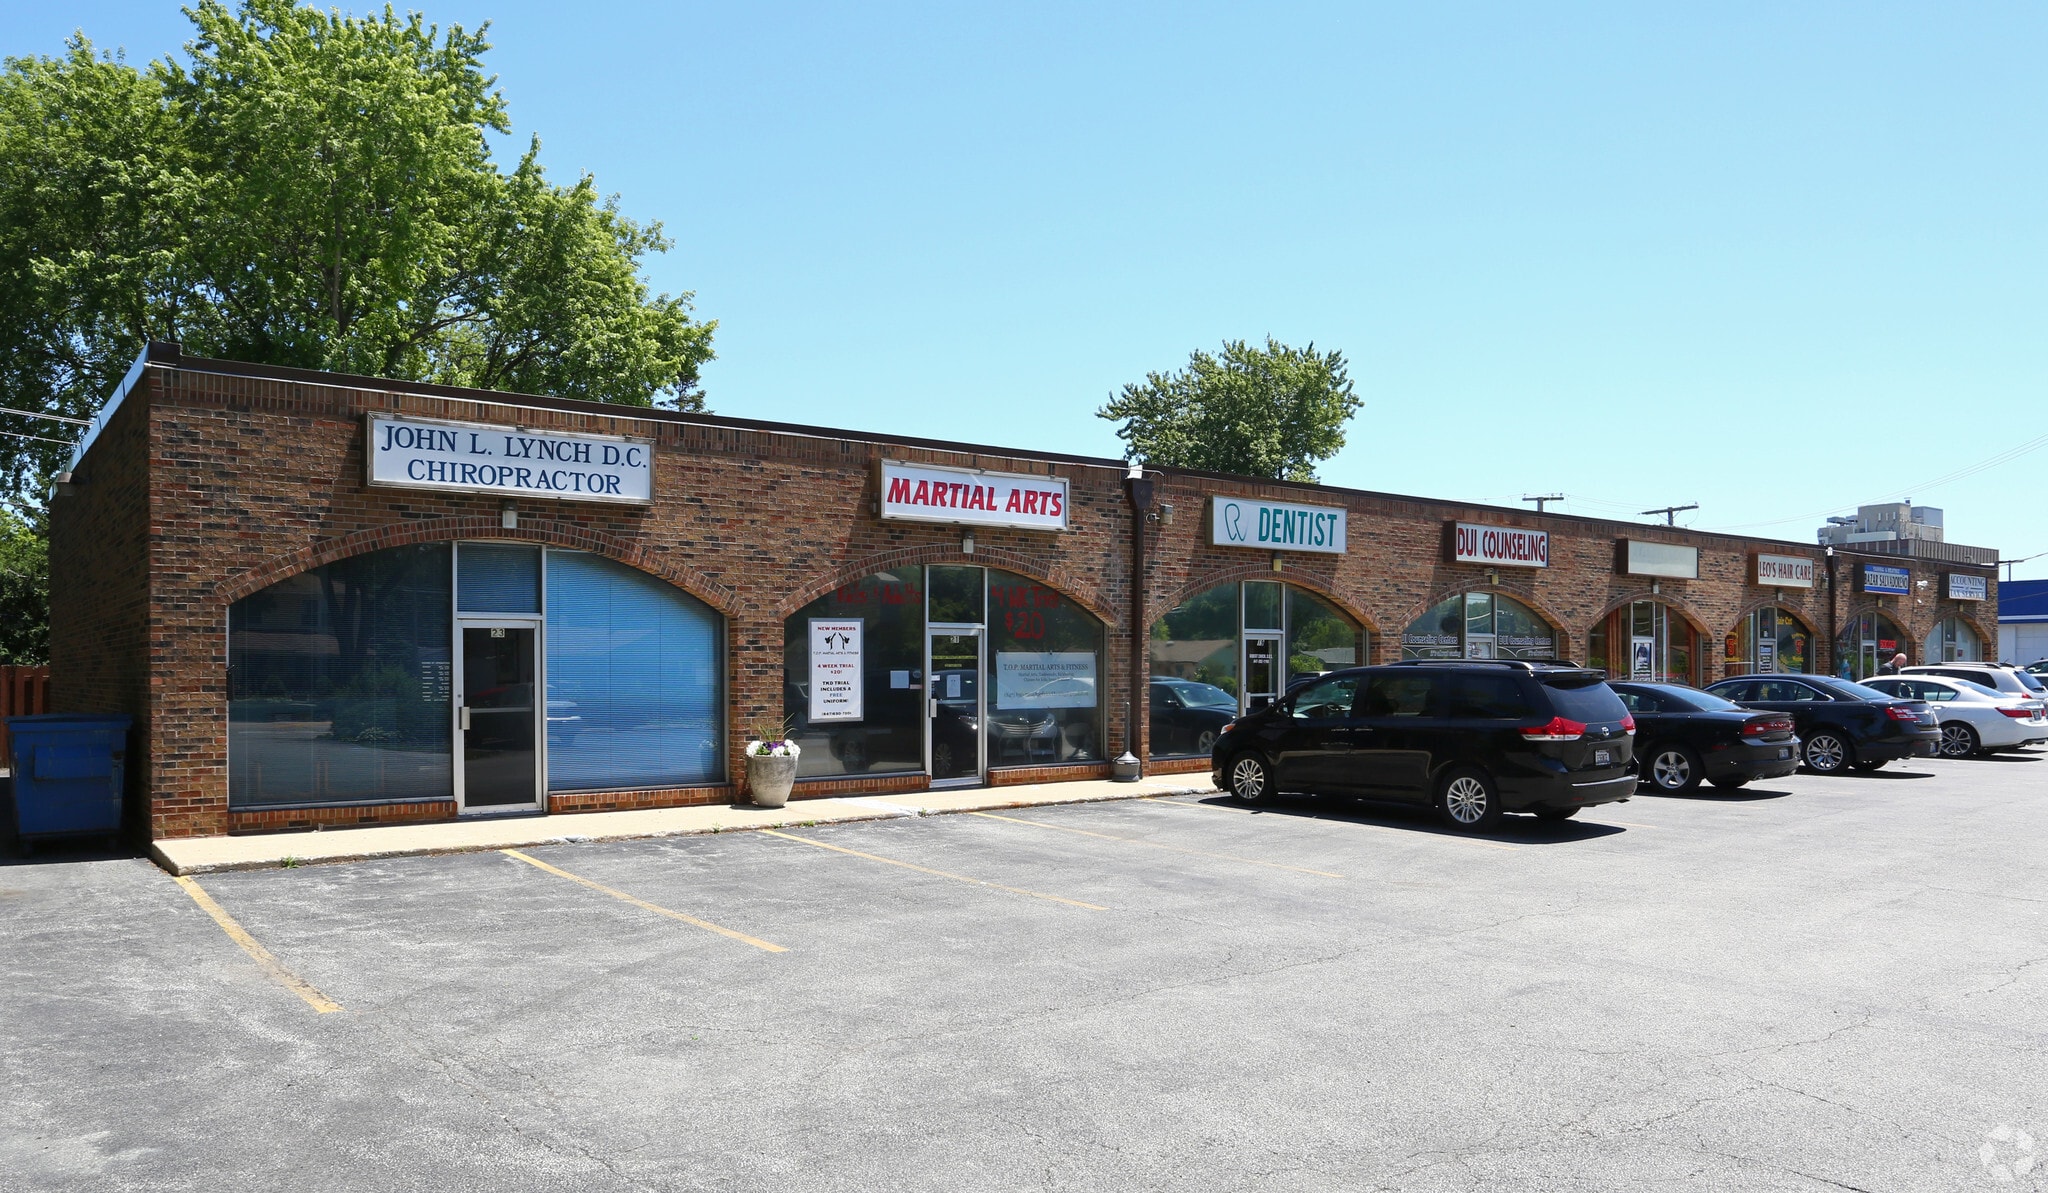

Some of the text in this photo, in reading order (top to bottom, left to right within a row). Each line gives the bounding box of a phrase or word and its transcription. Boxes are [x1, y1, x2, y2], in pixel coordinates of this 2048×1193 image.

[382, 425, 647, 468] JOHN L. LYNCH D.C.
[407, 459, 622, 494] CHIROPRACTOR
[887, 477, 1063, 517] MARTIAL ARTS
[1258, 507, 1338, 547] DENTIST
[1457, 527, 1546, 562] DUI COUNSELING
[1759, 561, 1812, 580] LEO'S HAIR CARE
[1950, 575, 1985, 587] ACCOUNTING
[1962, 590, 1985, 599] SERVICE
[491, 628, 504, 637] 23
